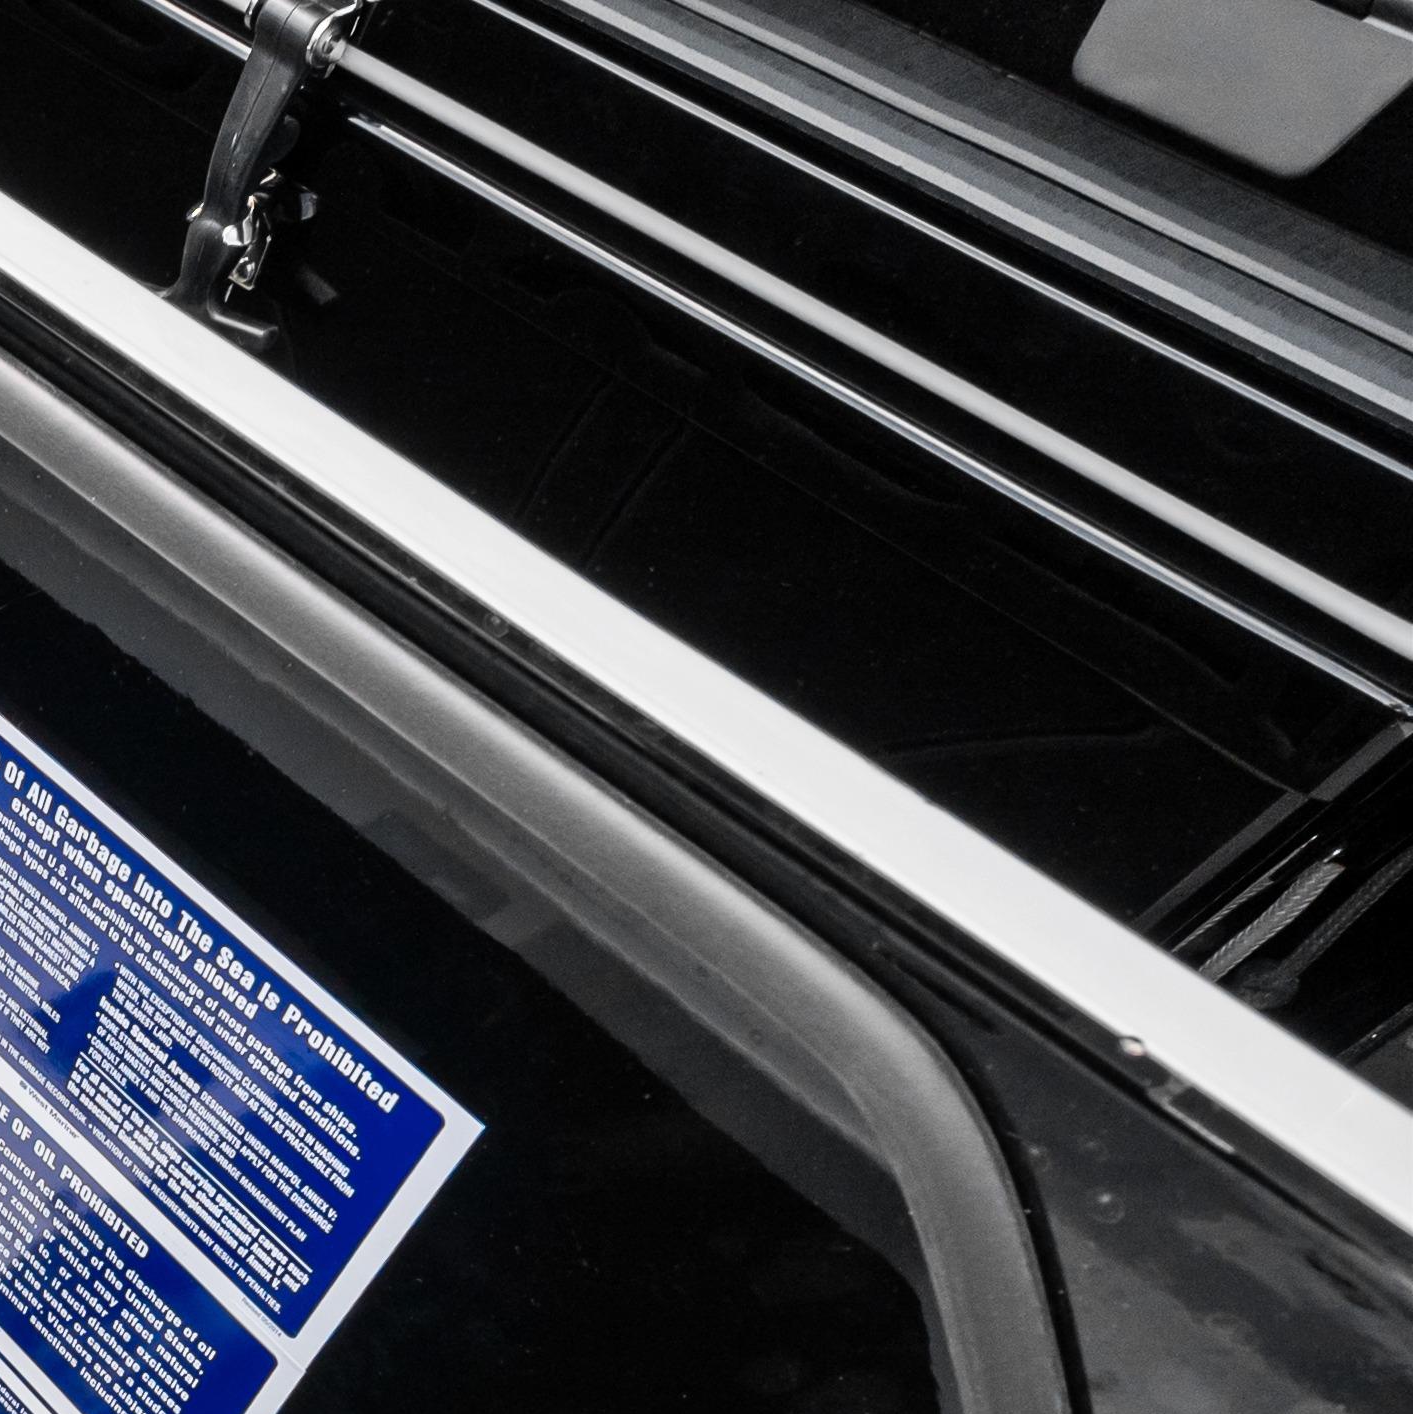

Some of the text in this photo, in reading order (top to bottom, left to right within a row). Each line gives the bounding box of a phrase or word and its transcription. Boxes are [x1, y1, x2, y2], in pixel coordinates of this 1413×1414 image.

[2, 760, 26, 790] Of
[25, 780, 53, 815] All
[53, 803, 132, 883] Garbage
[132, 872, 173, 919] Into
[176, 908, 213, 953] The
[214, 945, 255, 991] Sea
[256, 980, 281, 1011] Is
[280, 1002, 400, 1113] Prohibited
[10, 796, 259, 1020] except when specifically allowed
[21, 849, 49, 880] types
[48, 875, 67, 896] are
[66, 891, 109, 932] allowed
[107, 925, 120, 942] to
[119, 935, 135, 956] be
[134, 951, 194, 1008] discharged
[191, 1003, 216, 1027] and
[213, 1023, 250, 1056] under
[246, 1052, 300, 1103] specified
[297, 1098, 361, 1161] conditions.
[26, 837, 47, 860] and
[46, 853, 68, 881] U.S.
[69, 874, 93, 901] Law
[91, 896, 134, 937] prohibit
[132, 930, 152, 953] the
[151, 949, 204, 1000] discharge
[203, 996, 219, 1012] of
[216, 1007, 247, 1038] most
[244, 1033, 294, 1079] garbage
[292, 1073, 323, 1105] from
[321, 1100, 357, 1138] ships.
[98, 994, 131, 1030] Inside
[128, 1023, 169, 1065] Special
[166, 1058, 201, 1094] Areas
[198, 1089, 246, 1136] DESIGNATED
[242, 1130, 271, 1160] UNDER
[268, 1154, 302, 1189] MARPOL
[299, 1184, 330, 1213] ANNEX
[98, 1012, 333, 1234] MORE STRINGENT DISCHARGE REQUIREMENTS APPLY FOR THE DISCHARGE
[114, 975, 140, 1005] WATER,
[139, 997, 155, 1017] THE
[152, 1010, 172, 1030] SHIP
[168, 1024, 192, 1049] MUST
[207, 1060, 234, 1089] ROUTE
[230, 1082, 250, 1102] AND
[256, 1105, 275, 1125] FAR
[281, 1128, 333, 1178] PRACTICABLE
[328, 1171, 355, 1198] FROM
[118, 963, 138, 986] WITH
[135, 979, 151, 998] THE
[148, 991, 187, 1031] EXCEPTION
[194, 1033, 244, 1081] DISCHARGING
[240, 1075, 278, 1113] CLEANING
[274, 1107, 307, 1138] AGENTS
[312, 1139, 350, 1178] WASHING
[9, 1194, 38, 1229] zone,
[41, 1227, 56, 1243] or
[57, 1242, 91, 1280] which
[92, 1279, 119, 1308] may
[119, 1307, 154, 1344] affect
[154, 1343, 199, 1389] natural
[10, 1116, 32, 1141] OF
[32, 1138, 56, 1170] OIL
[58, 1163, 149, 1258] PROHIBITED
[34, 1177, 55, 1201] Act
[53, 1197, 105, 1250] prohibits
[104, 1246, 125, 1270] the
[124, 1268, 182, 1328] discharge
[181, 1326, 198, 1343] of
[196, 1340, 216, 1361] oil
[51, 1215, 89, 1257] waters
[89, 1255, 104, 1271] of
[103, 1267, 123, 1291] the
[124, 1287, 164, 1331] United
[163, 1327, 204, 1375] States,
[12, 1237, 48, 1281] States,
[50, 1276, 62, 1291] if
[60, 1287, 87, 1318] such
[86, 1315, 141, 1373] discharge
[140, 1371, 182, 1414] causes
[37, 1242, 52, 1264] to,
[57, 1265, 72, 1280] or
[74, 1282, 109, 1318] under
[111, 1318, 131, 1342] the
[135, 1344, 189, 1402] exclusive
